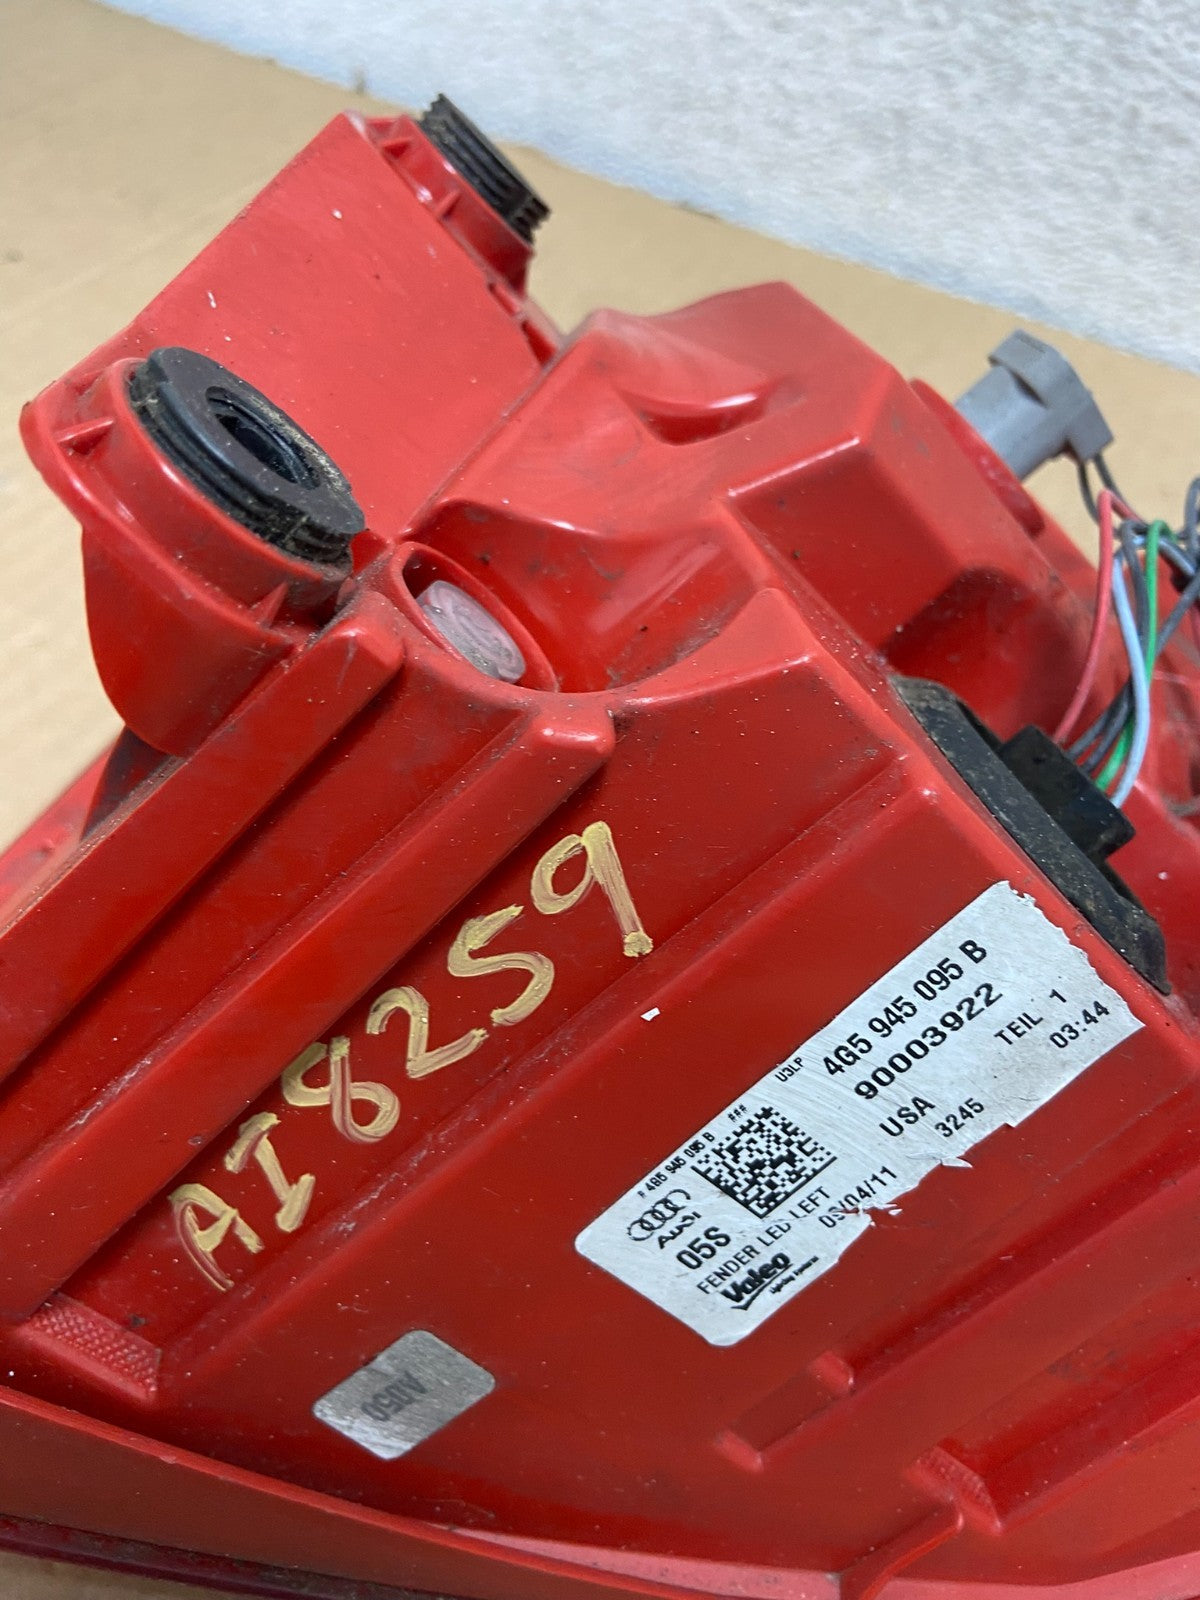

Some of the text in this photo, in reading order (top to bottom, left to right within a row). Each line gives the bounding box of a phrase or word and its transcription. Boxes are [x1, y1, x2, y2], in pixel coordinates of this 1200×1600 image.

[823, 939, 987, 1076] 4G5 945 095 B
[994, 988, 1067, 1045] TEIL 1
[1049, 1000, 1110, 1049] 03:44
[854, 982, 1003, 1100] 90003922
[774, 1057, 804, 1082] U3LP
[879, 1096, 935, 1137] USA
[934, 1098, 985, 1138] 3245
[676, 1226, 732, 1270] 05S
[696, 1244, 761, 1295] FENDER
[756, 1222, 792, 1247] LED
[788, 1186, 830, 1219] LEFT
